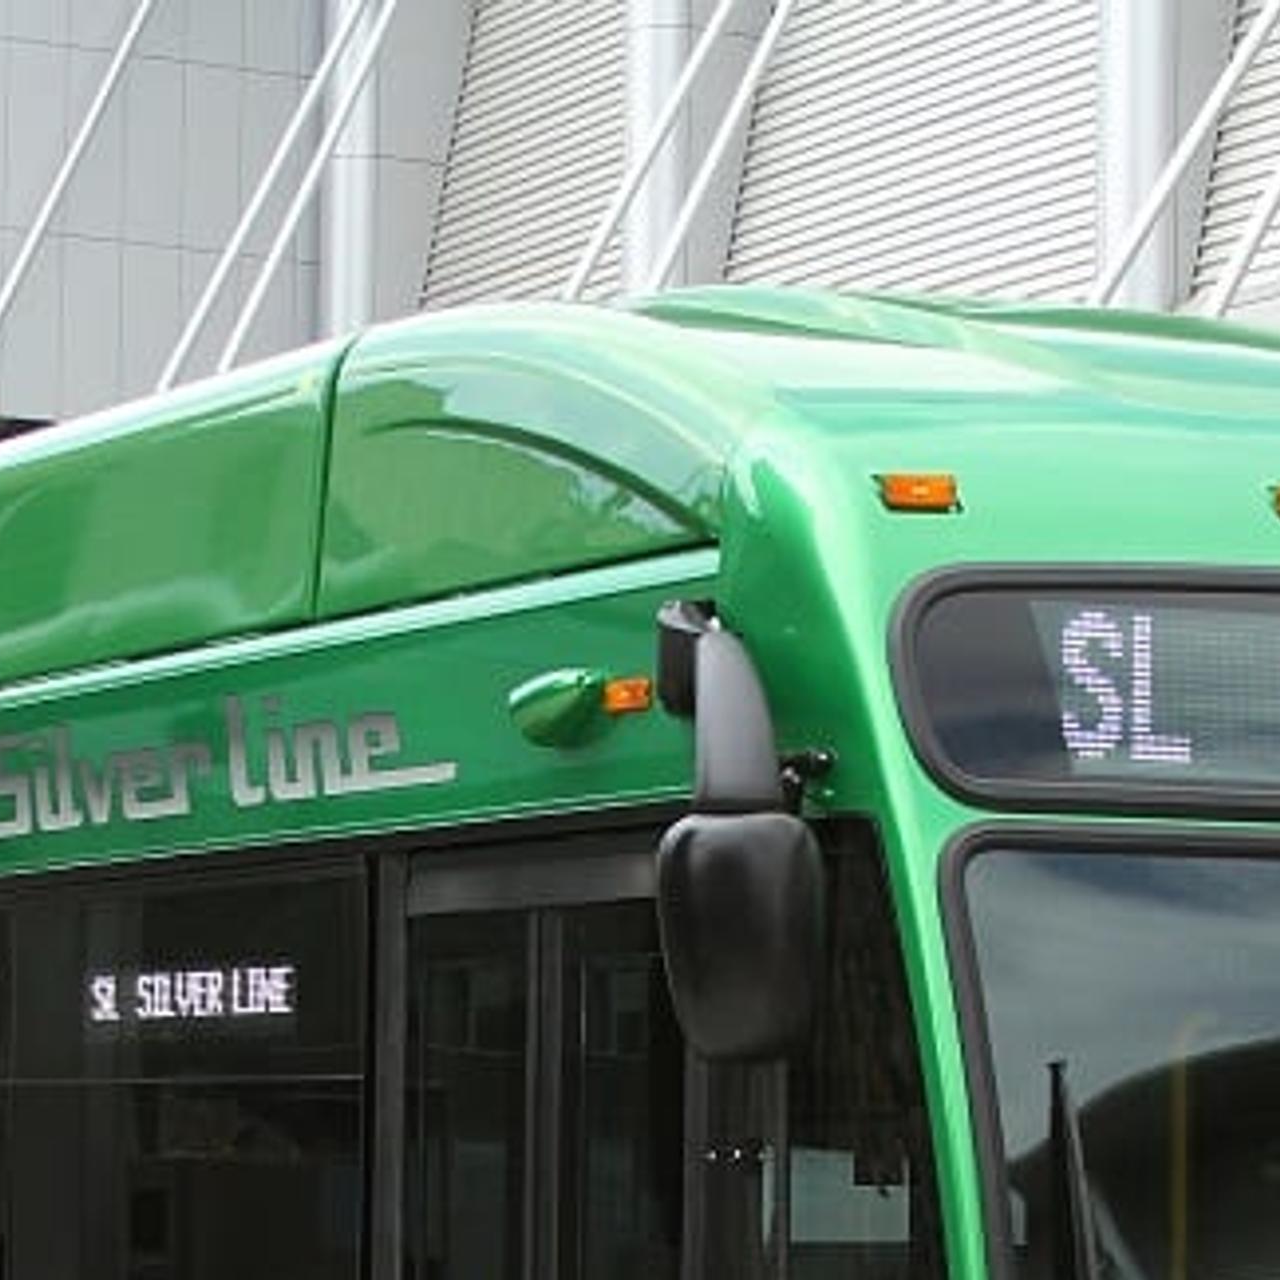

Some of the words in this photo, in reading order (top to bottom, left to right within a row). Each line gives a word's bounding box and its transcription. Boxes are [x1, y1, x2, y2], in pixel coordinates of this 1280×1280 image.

[1062, 611, 1192, 762] SL
[90, 974, 121, 1022] SL
[134, 970, 224, 1019] SILVER
[231, 966, 295, 1014] LINE
